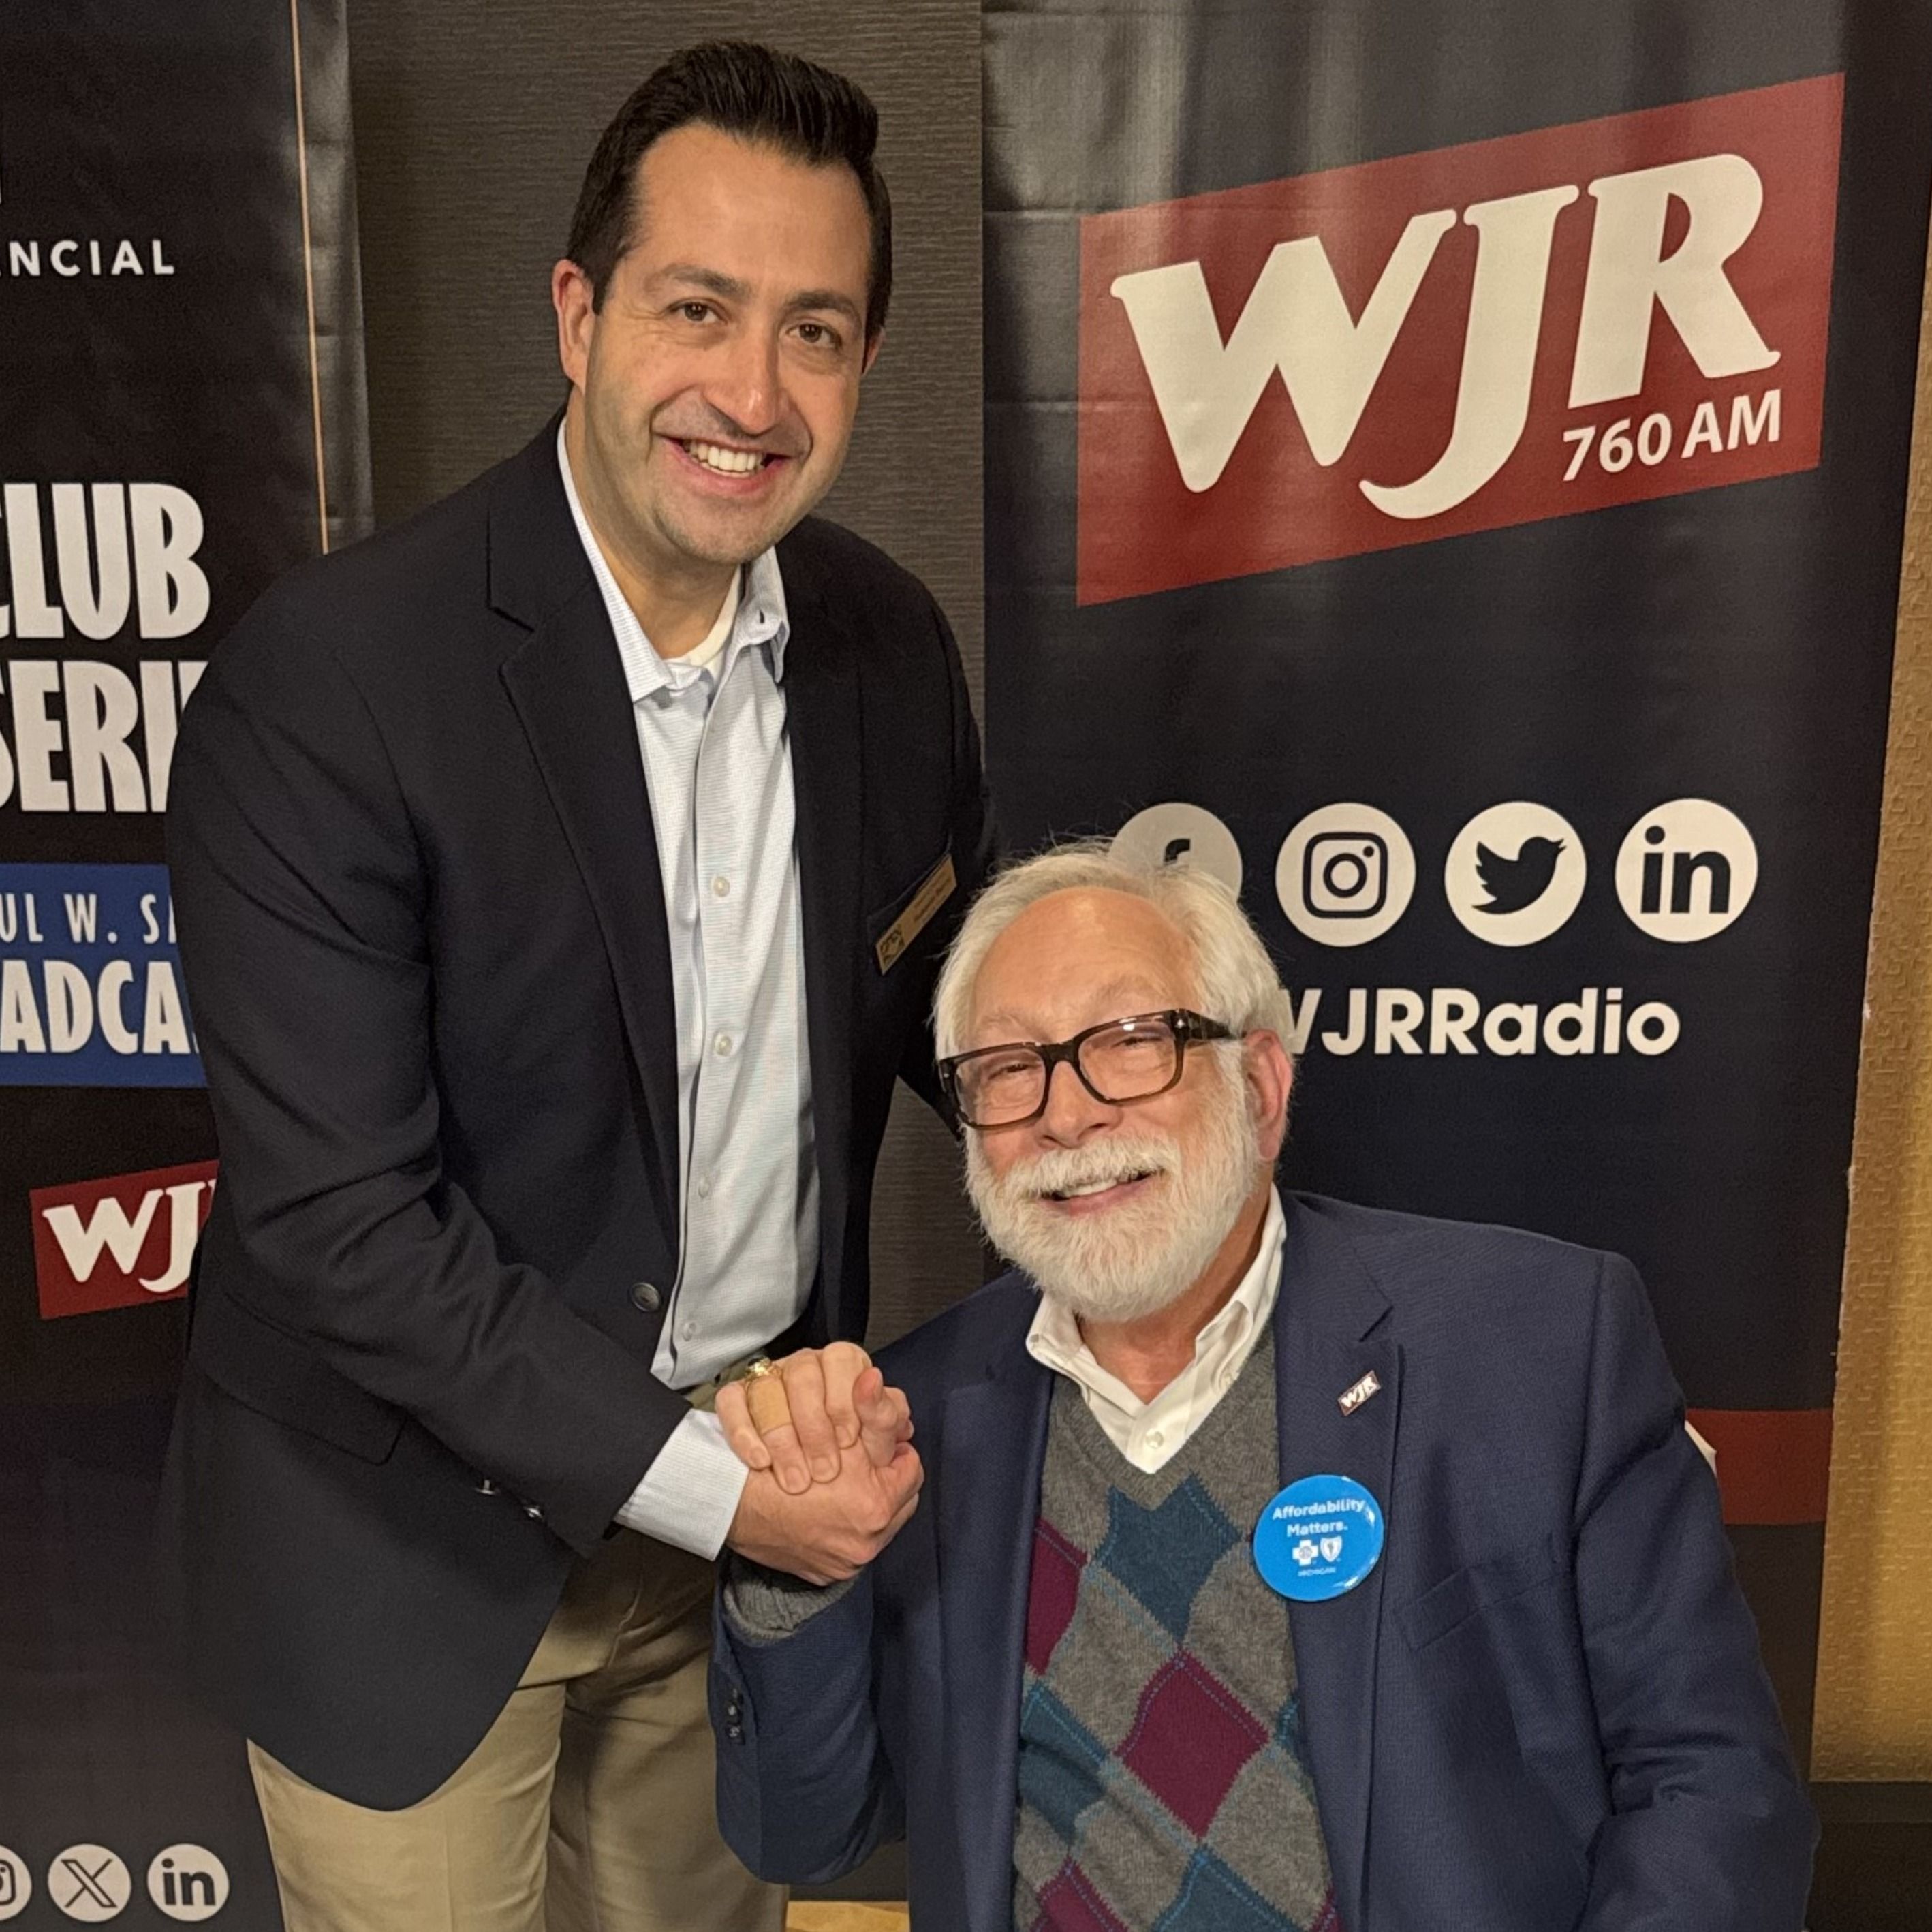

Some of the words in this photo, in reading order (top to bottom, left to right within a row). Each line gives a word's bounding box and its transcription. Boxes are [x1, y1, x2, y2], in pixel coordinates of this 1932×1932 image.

[8, 239, 175, 277] NCIAL
[1109, 153, 1781, 520] WJR
[1563, 412, 1672, 482] 760
[1681, 388, 1781, 459] AM
[0, 482, 211, 640] LUB
[0, 660, 208, 813] ERI
[63, 893, 118, 944] W.
[140, 893, 177, 944] S
[0, 959, 200, 1055] ADCA
[42, 1179, 216, 1294] WJ
[1341, 1376, 1377, 1408] WJR
[1272, 1498, 1365, 1521] Affordability
[1286, 1521, 1349, 1538] Matters.
